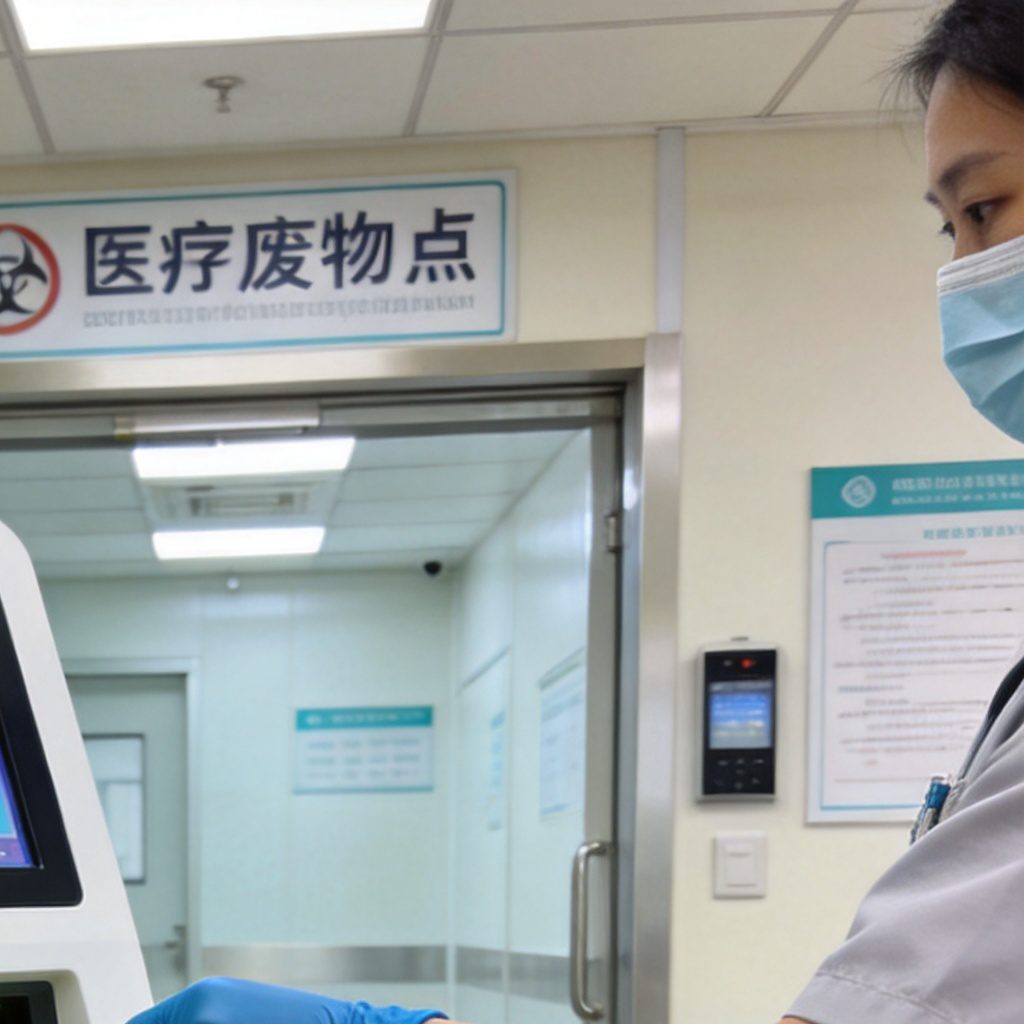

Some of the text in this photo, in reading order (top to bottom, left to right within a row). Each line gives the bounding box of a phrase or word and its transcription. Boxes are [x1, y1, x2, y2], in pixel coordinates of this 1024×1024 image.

[84, 208, 477, 297] 医疗废物点
